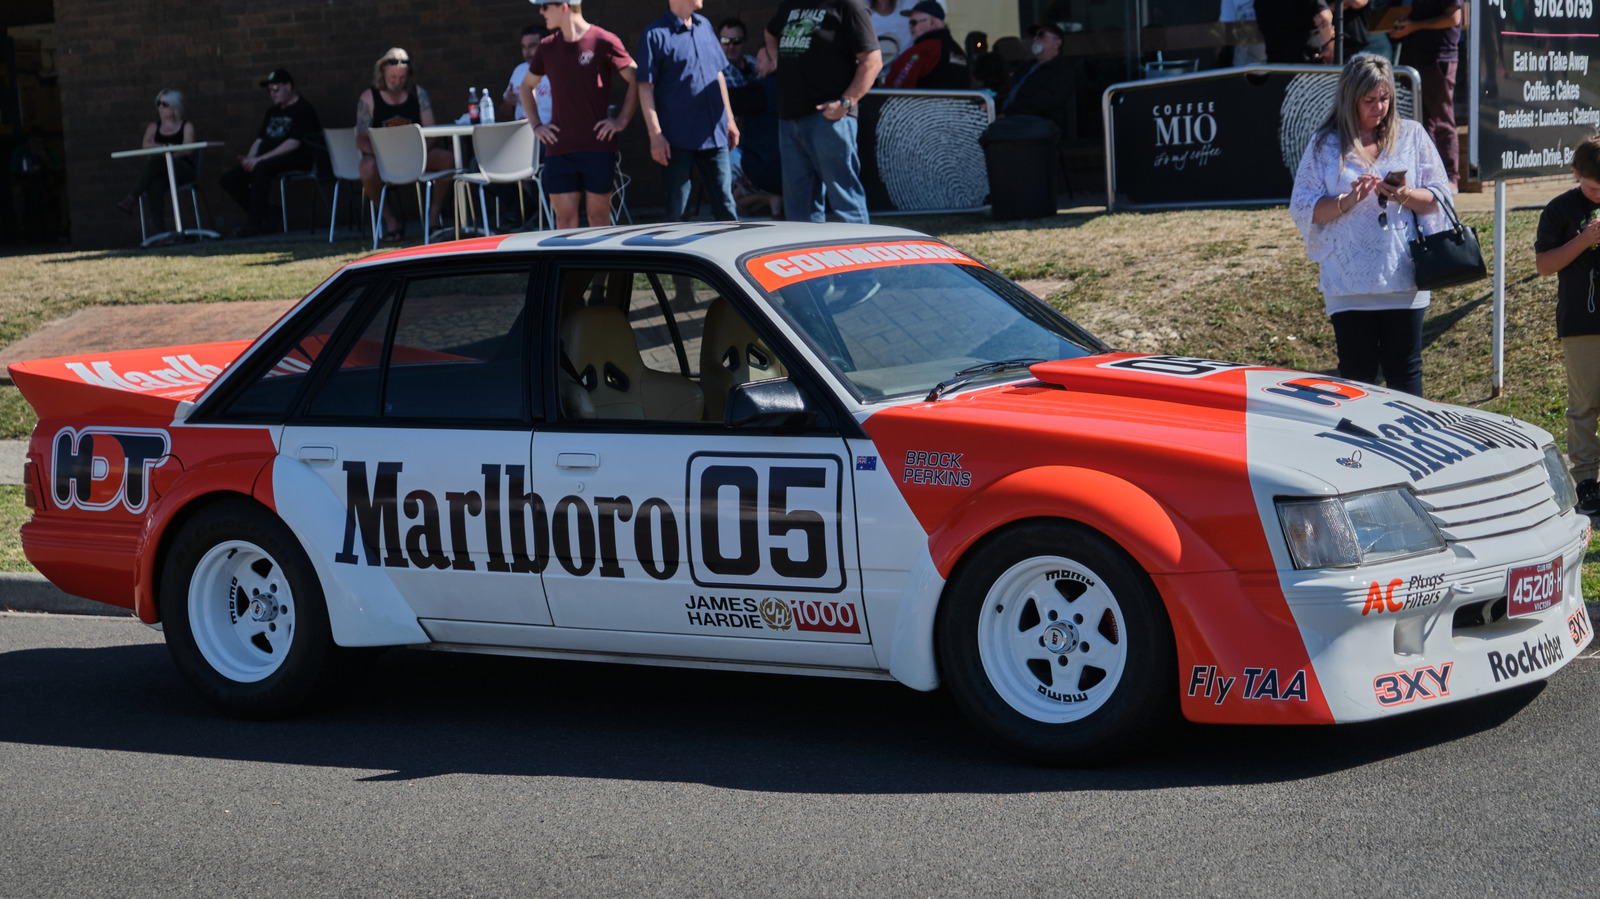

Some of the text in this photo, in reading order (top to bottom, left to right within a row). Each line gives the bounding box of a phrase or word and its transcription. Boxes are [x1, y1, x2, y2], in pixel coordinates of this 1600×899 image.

[779, 36, 812, 49] GARAGE
[1513, 50, 1589, 76] Eat in or Take Away
[1523, 81, 1550, 102] Coffee
[1556, 80, 1580, 100] Cakes
[1152, 101, 1215, 116] COFFEE
[1498, 109, 1534, 128] Breakfast
[1539, 108, 1569, 127] Lunches
[1573, 106, 1600, 128] Catering
[1154, 113, 1218, 146] MIO
[1189, 144, 1222, 166] coffee
[1501, 150, 1513, 169] 1/8
[1513, 149, 1542, 169] London
[1543, 148, 1564, 168] Drive,
[763, 245, 972, 278] COMMODORE
[52, 426, 171, 514] HDT
[905, 450, 963, 469] BROCK
[903, 467, 972, 487] PERKINS
[335, 460, 680, 580] Marlboro
[700, 465, 828, 578] 05
[1408, 573, 1445, 591] Plugs
[685, 595, 757, 613] JAMES
[1362, 578, 1403, 616] AC
[1402, 591, 1441, 611] Filters
[687, 611, 763, 630] HARDIE
[1567, 603, 1590, 647] 3XY
[1487, 634, 1564, 683] Rocktober
[1188, 665, 1308, 705] Fly TAA
[1374, 662, 1453, 707] 3XY
